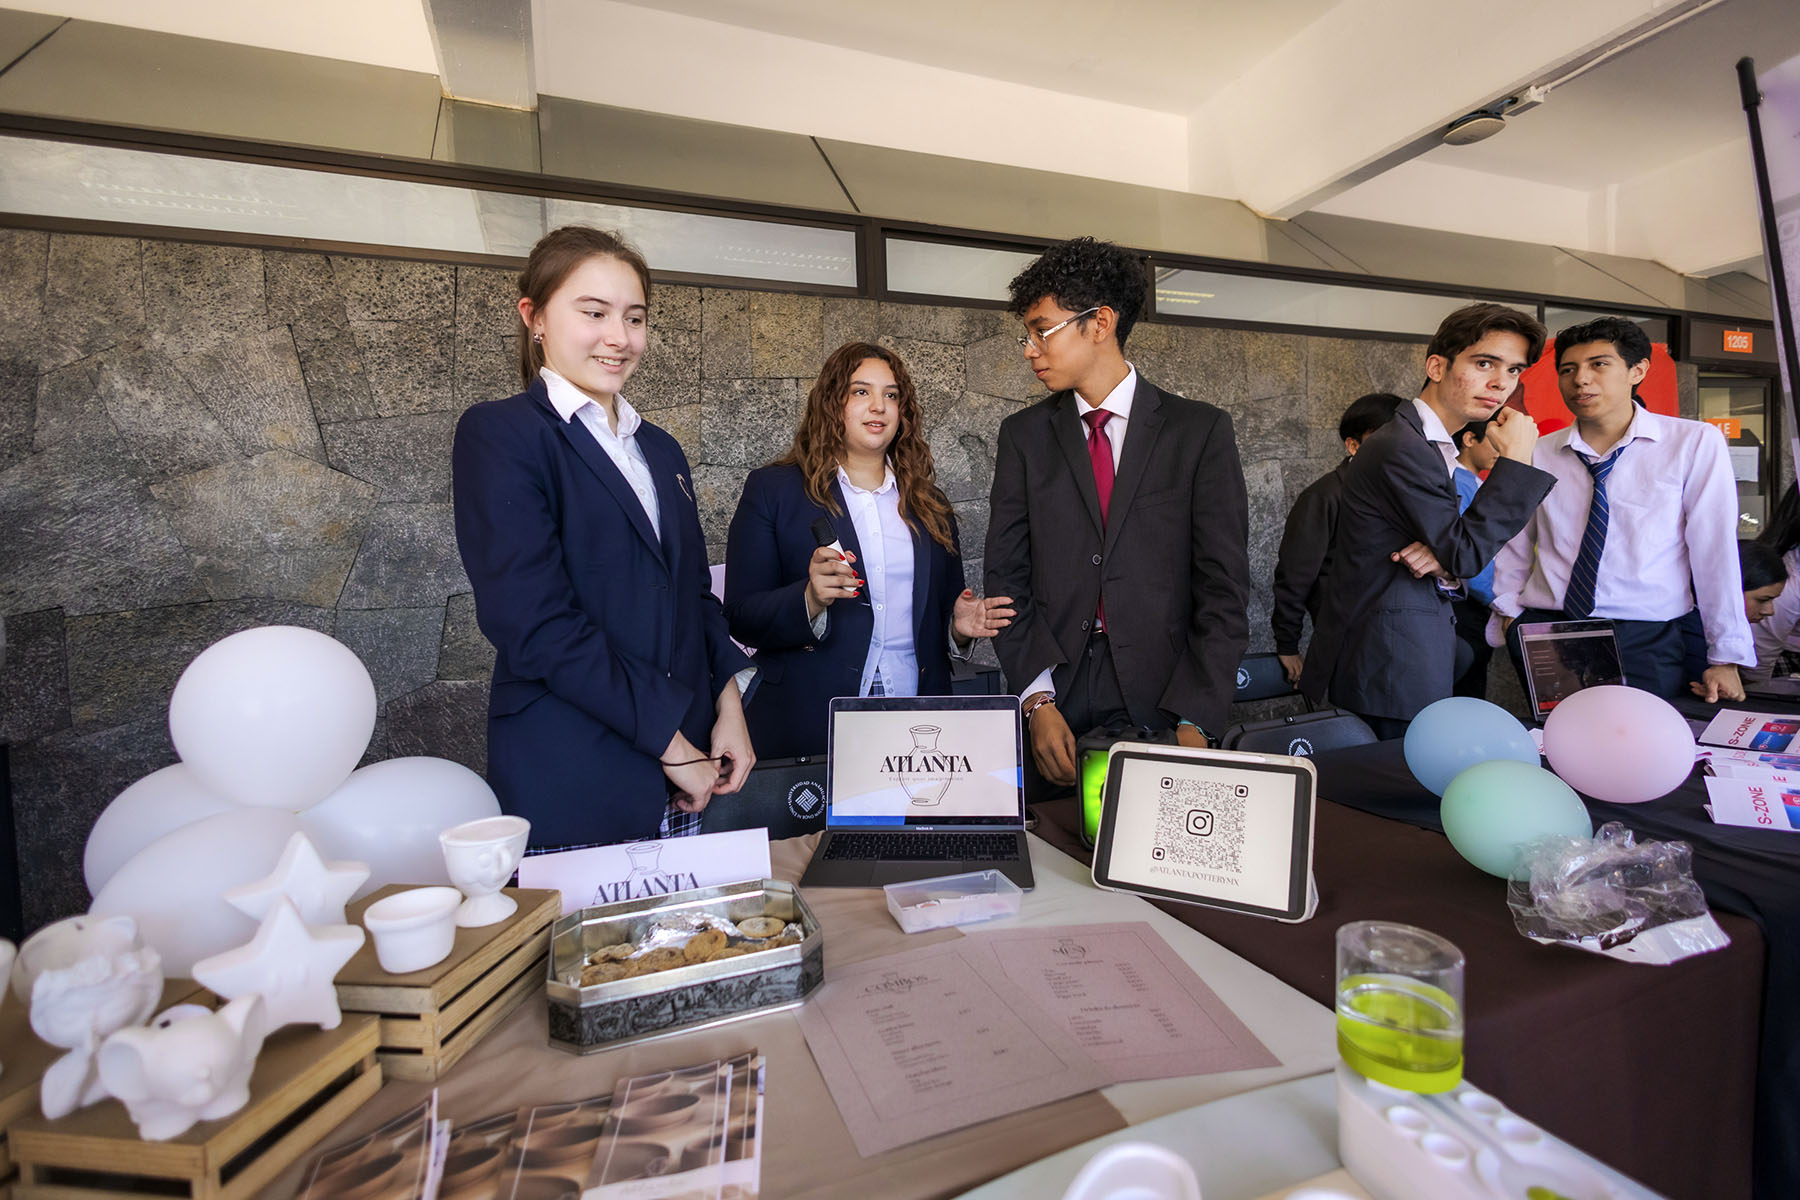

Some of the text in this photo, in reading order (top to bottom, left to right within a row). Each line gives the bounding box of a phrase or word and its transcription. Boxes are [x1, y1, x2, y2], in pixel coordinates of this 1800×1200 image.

[1727, 335, 1749, 349] 1205
[1728, 717, 1757, 745] S-ZONE
[880, 755, 973, 773] ATLANTA
[1748, 785, 1773, 825] S-ZONE
[592, 872, 699, 906] ATLANTA
